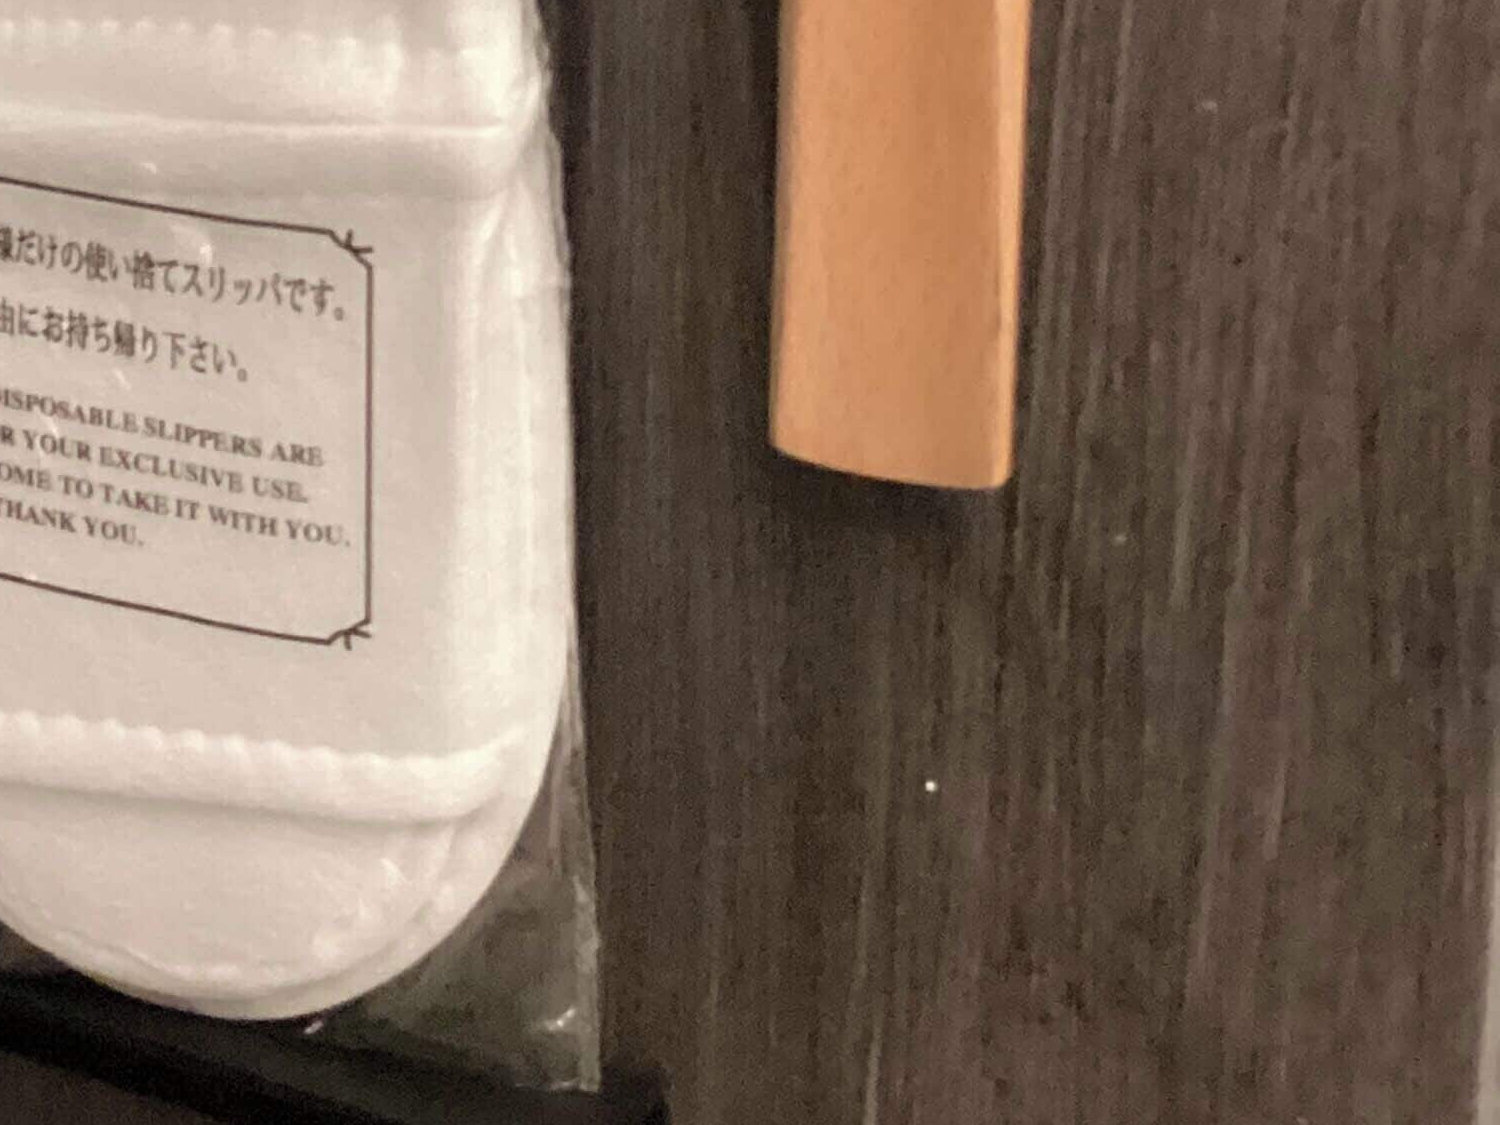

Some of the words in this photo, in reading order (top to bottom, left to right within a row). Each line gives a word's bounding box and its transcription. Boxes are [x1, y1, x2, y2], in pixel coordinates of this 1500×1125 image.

[22, 430, 92, 463] YOUR
[100, 448, 244, 495] EXCLUSIVE
[251, 477, 309, 504] USE.
[142, 419, 263, 458] SLIPPERS
[269, 445, 324, 468] ARE
[58, 474, 94, 499] TO
[100, 483, 169, 513] TAKE
[174, 499, 201, 521] IT
[207, 504, 278, 538] WITH
